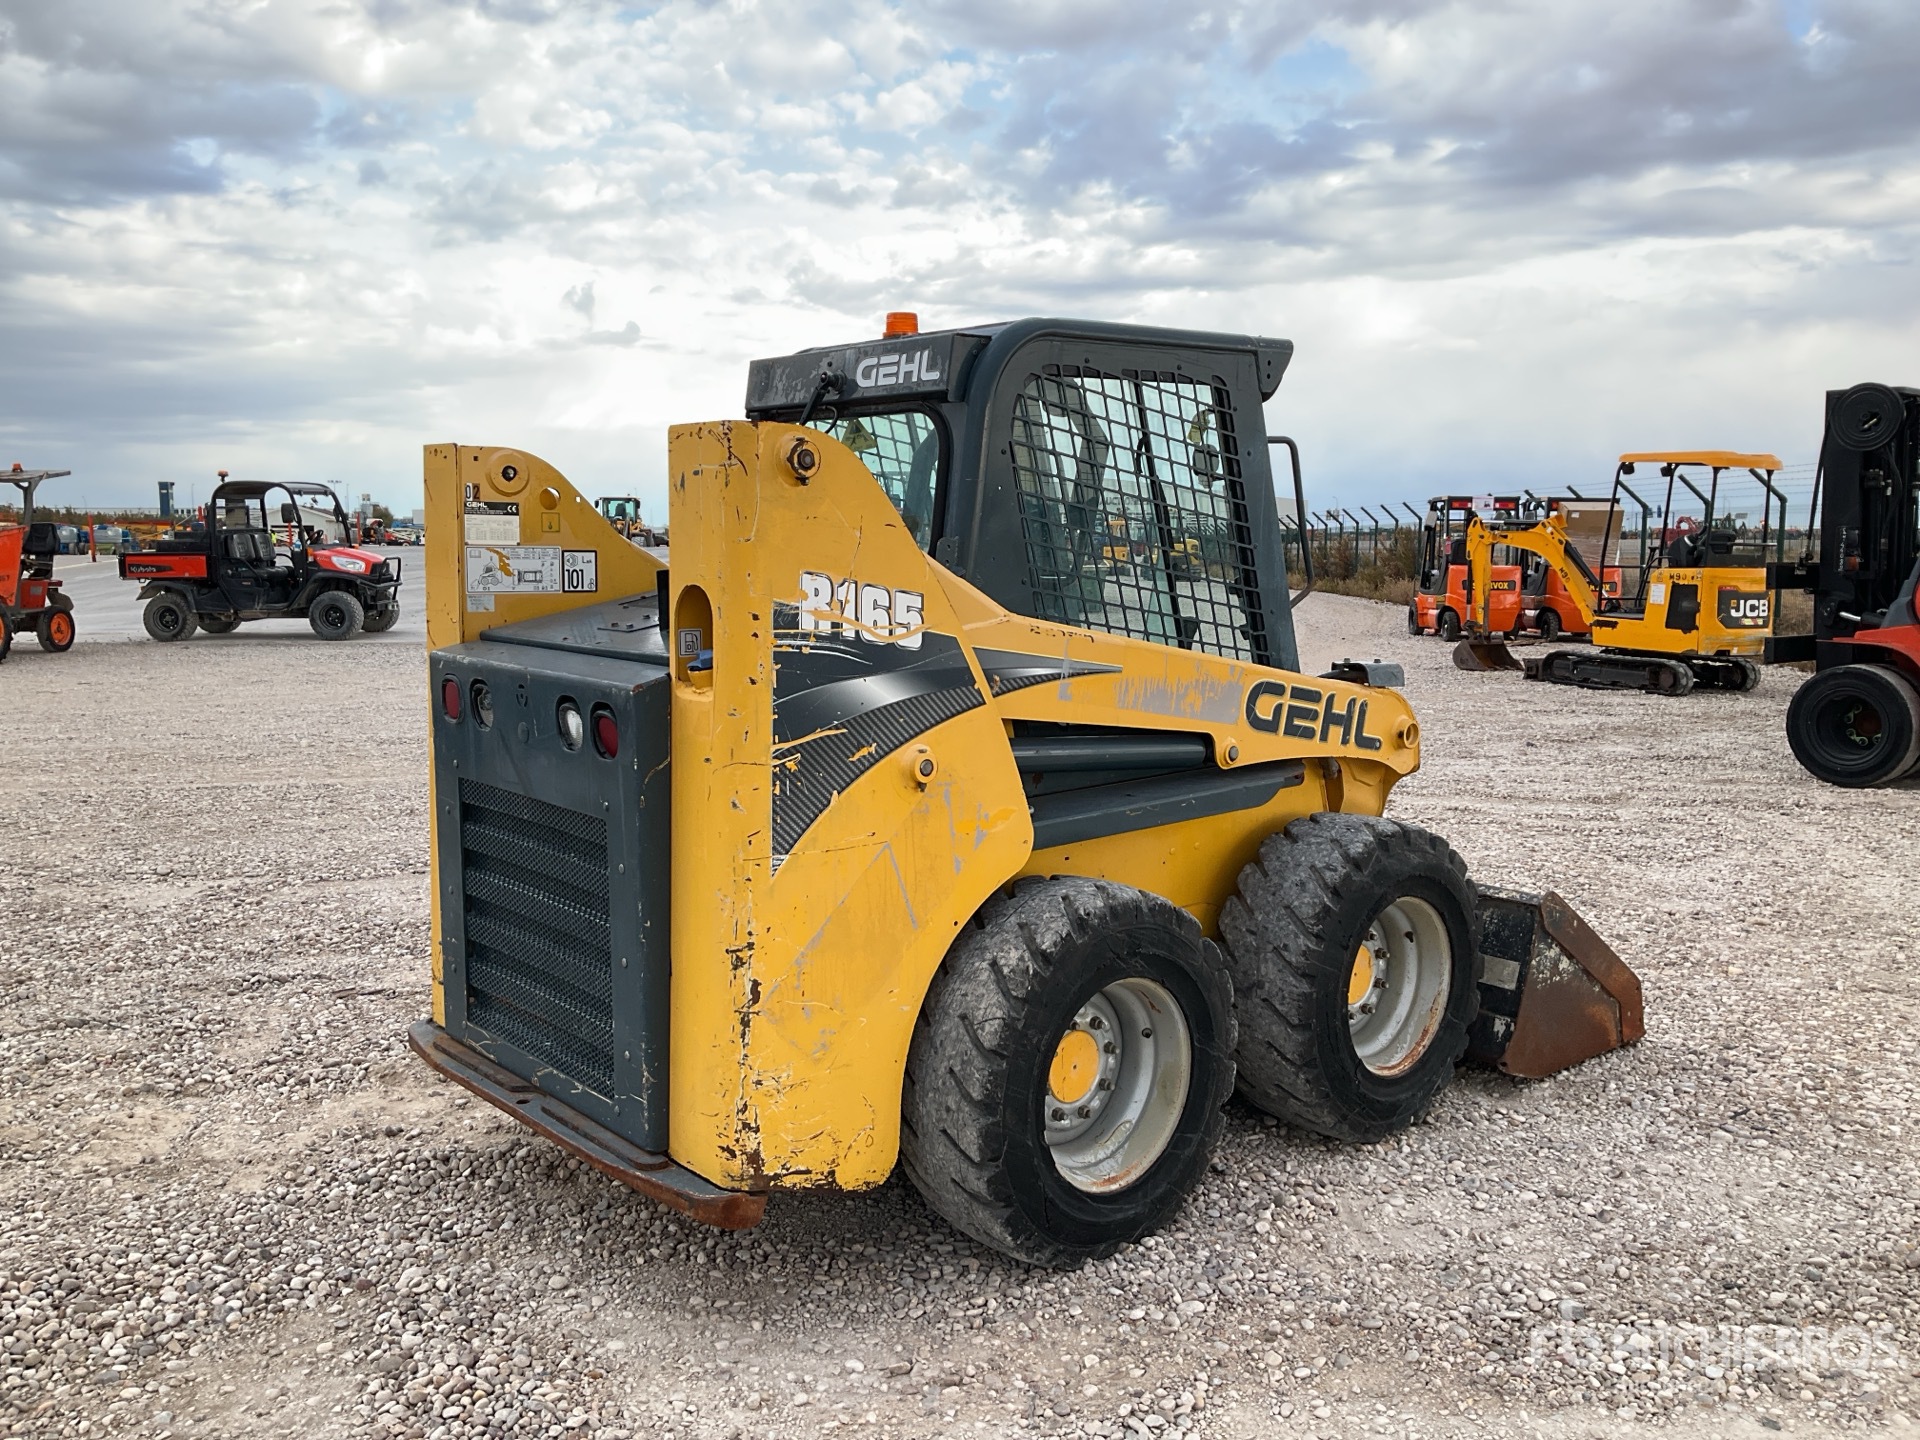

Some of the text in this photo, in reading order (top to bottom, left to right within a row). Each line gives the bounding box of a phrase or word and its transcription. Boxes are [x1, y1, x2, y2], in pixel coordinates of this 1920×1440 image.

[856, 350, 940, 388] GEHL
[565, 569, 584, 589] 101
[800, 570, 924, 651] R165
[1730, 599, 1768, 618] JCB
[1246, 679, 1383, 750] GEHL
